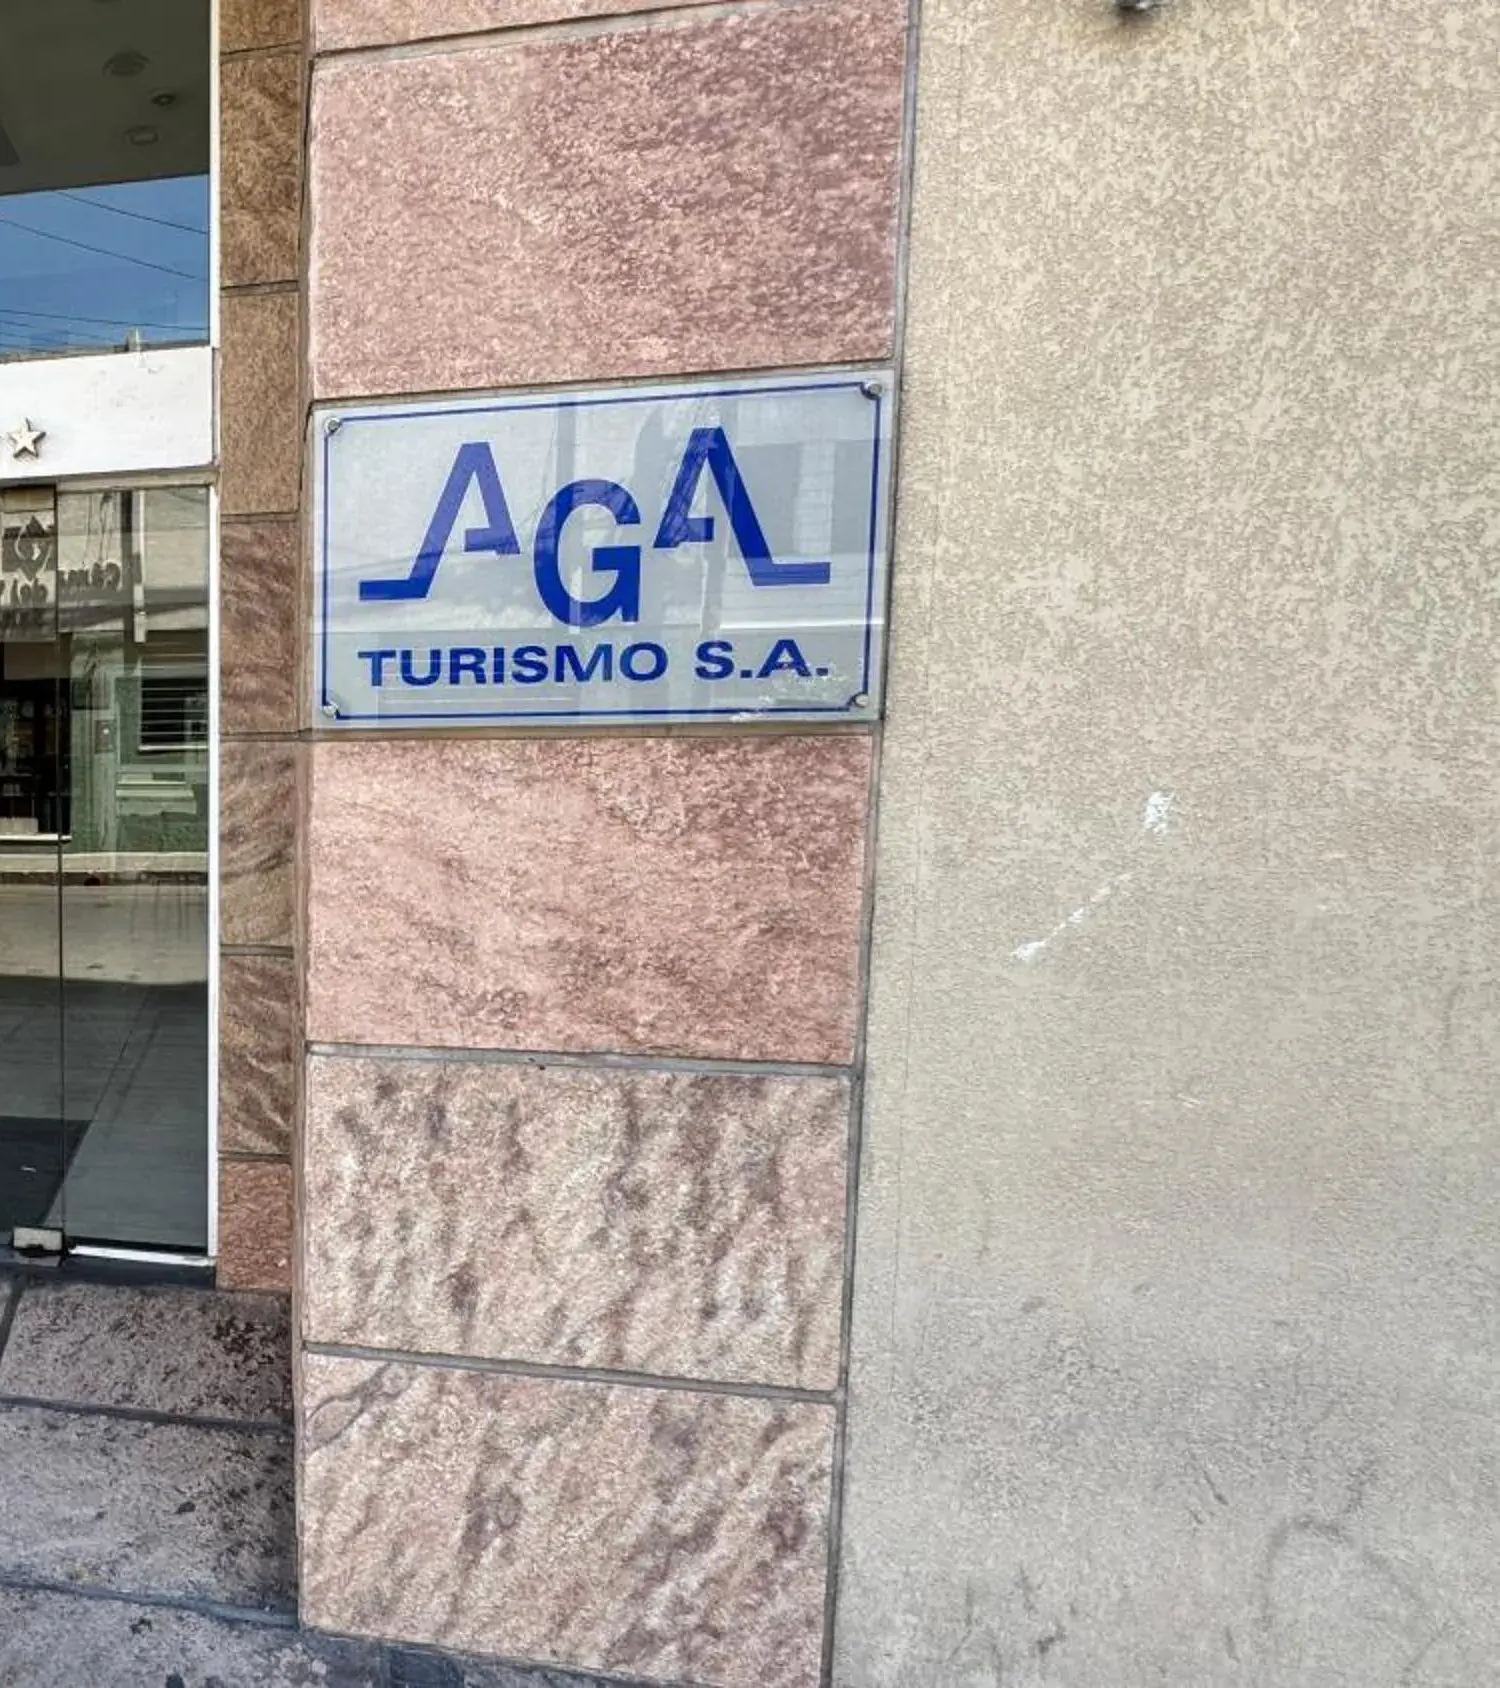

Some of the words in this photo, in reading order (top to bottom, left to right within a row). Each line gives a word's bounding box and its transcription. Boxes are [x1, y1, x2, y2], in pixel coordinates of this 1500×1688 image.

[358, 424, 831, 628] AGA
[357, 641, 669, 687] TURISMO
[694, 639, 831, 680] S.A.
